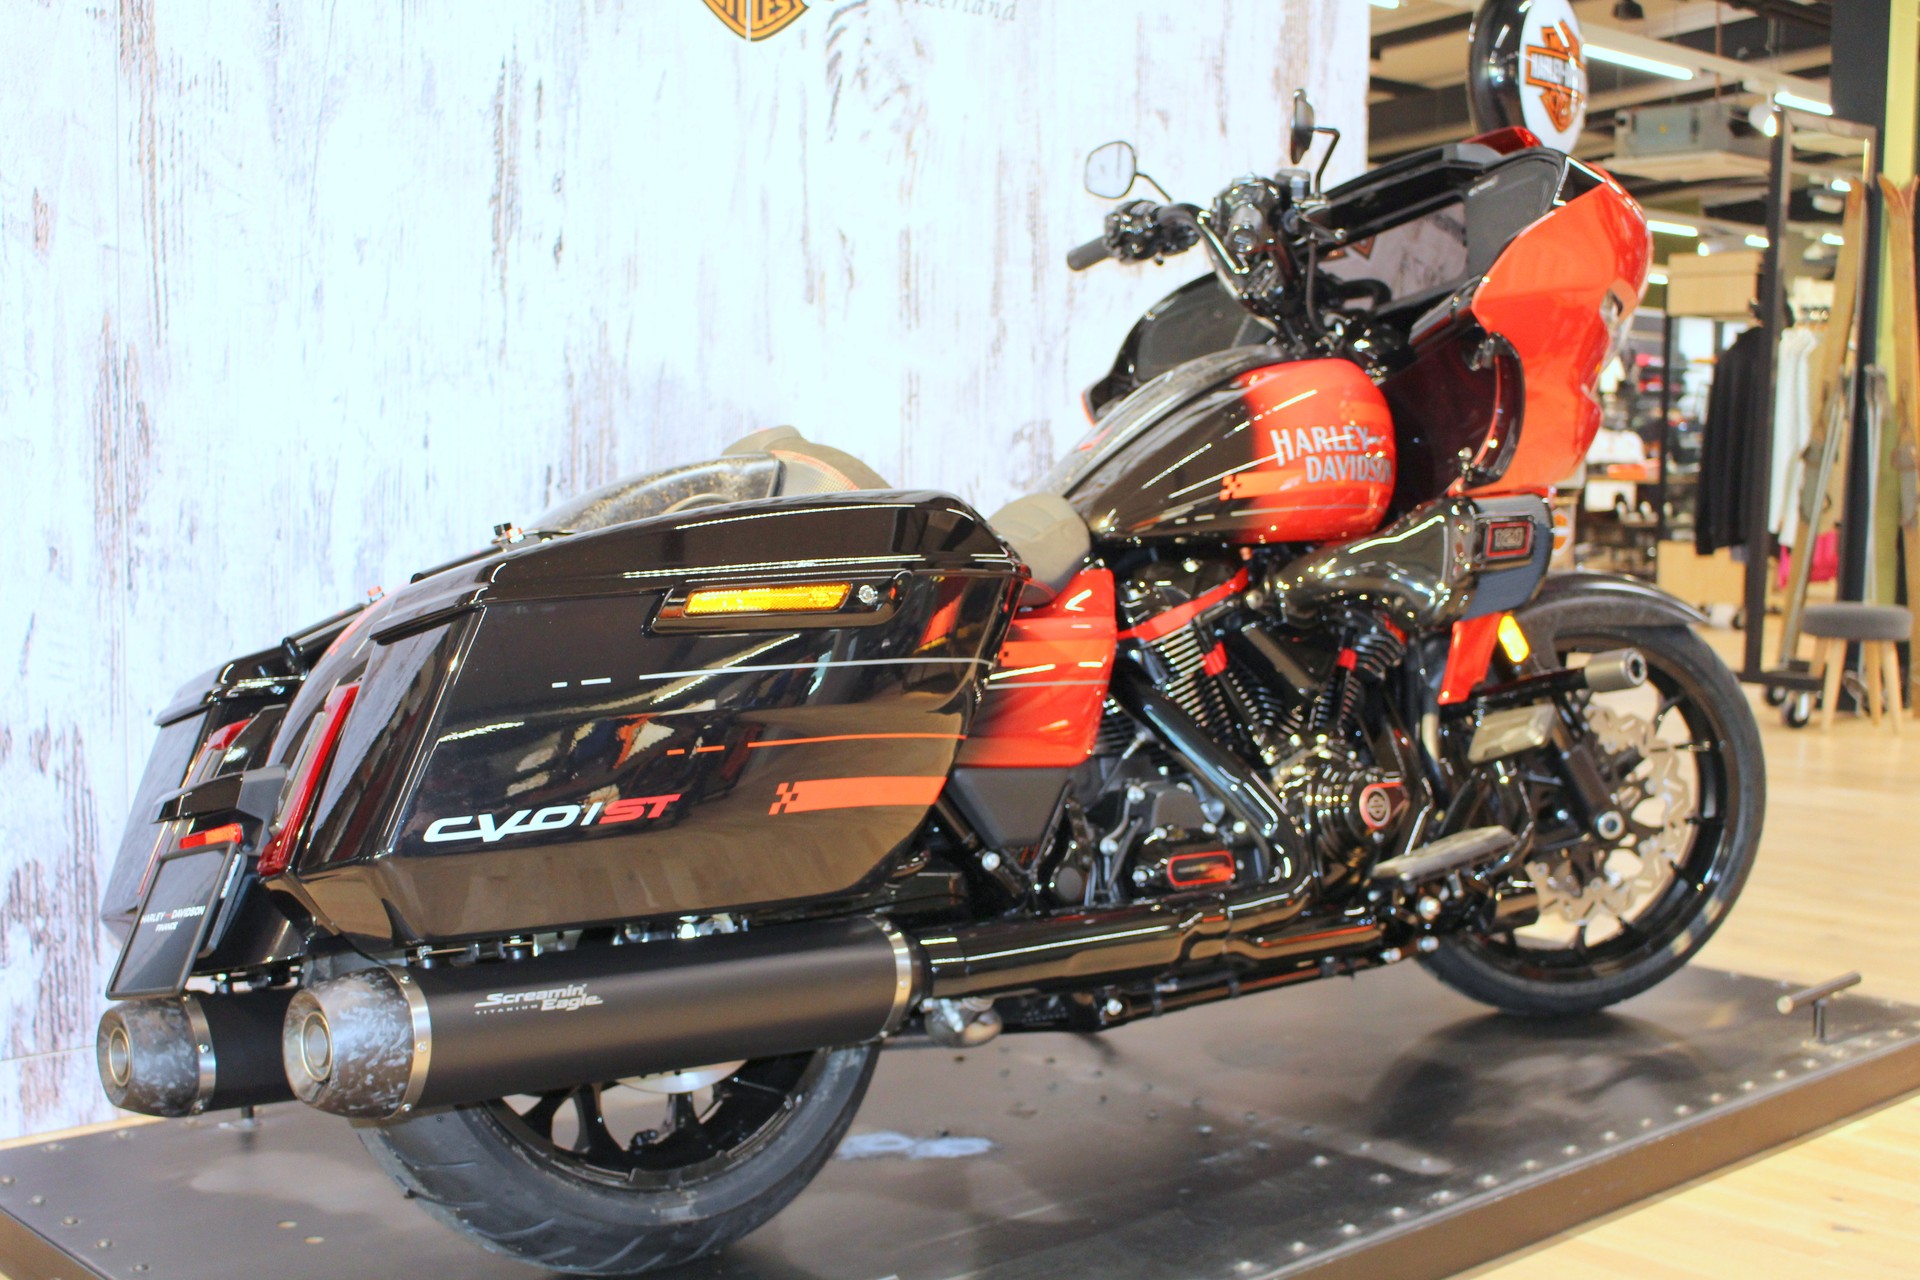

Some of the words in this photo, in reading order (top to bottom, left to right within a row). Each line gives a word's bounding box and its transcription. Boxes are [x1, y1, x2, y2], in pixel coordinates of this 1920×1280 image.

[1306, 454, 1392, 485] DAVIDSON
[475, 1004, 538, 1015] TITANIUM
[541, 994, 604, 1012] Eagle
